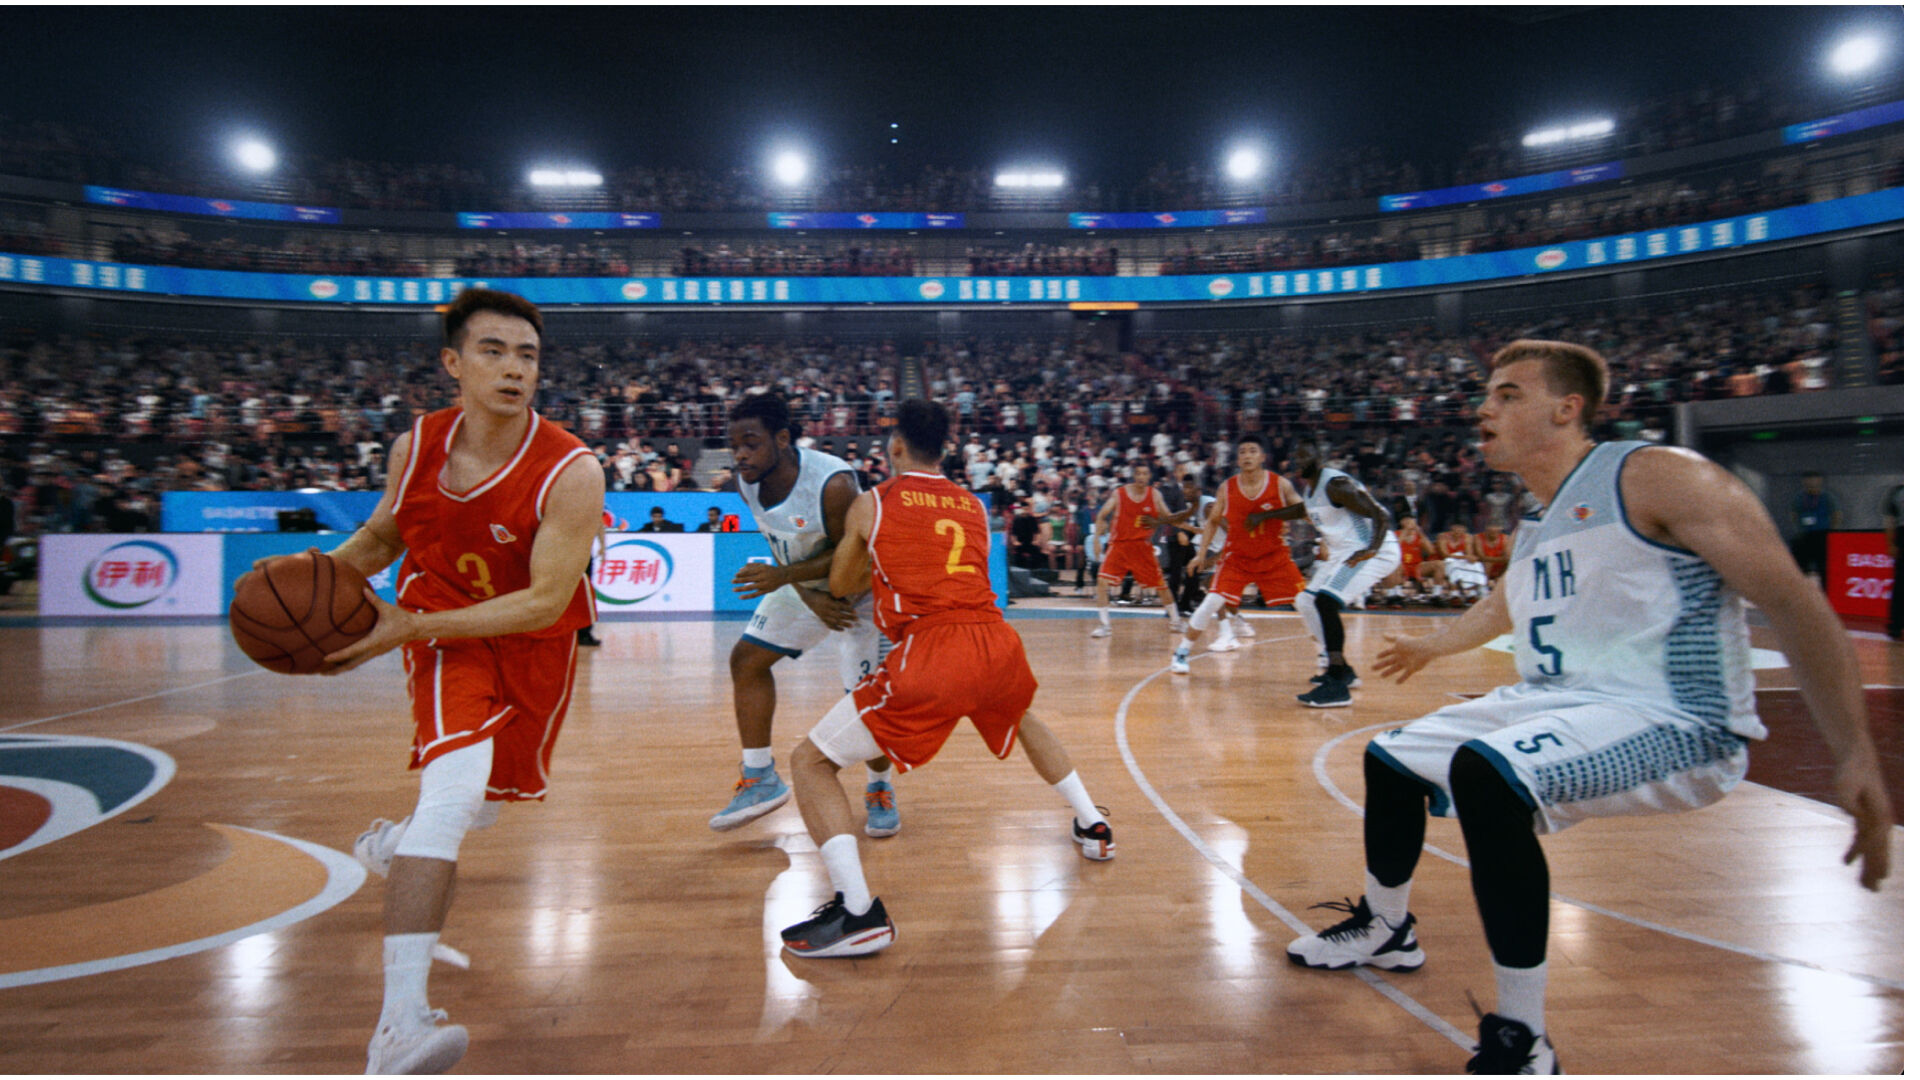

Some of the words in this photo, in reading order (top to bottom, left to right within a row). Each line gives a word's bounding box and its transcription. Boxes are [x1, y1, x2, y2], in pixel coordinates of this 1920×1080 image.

[900, 490, 937, 508] SUN
[934, 519, 976, 574] 2
[96, 560, 166, 588] 伊利
[456, 552, 496, 600] 3
[597, 560, 661, 585] 伊利
[1532, 549, 1576, 601] MH
[1531, 614, 1563, 676] 5
[1514, 732, 1564, 756] 5
